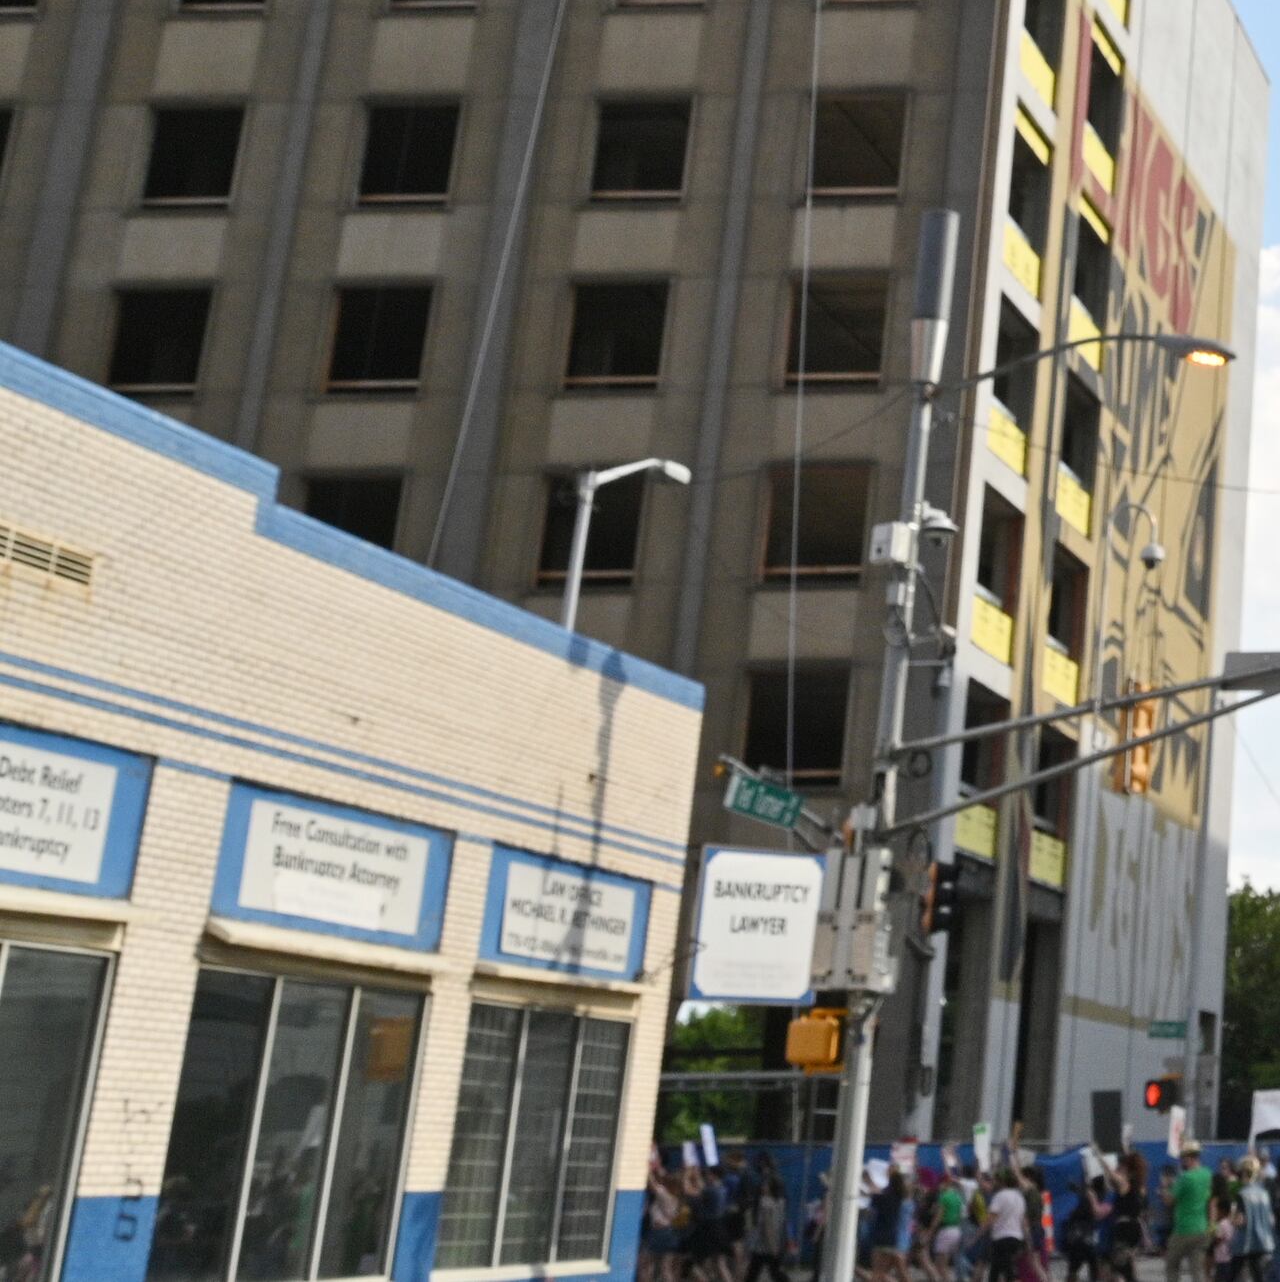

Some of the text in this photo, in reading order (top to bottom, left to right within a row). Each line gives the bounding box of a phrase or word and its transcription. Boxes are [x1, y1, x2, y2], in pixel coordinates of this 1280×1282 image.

[41, 764, 84, 794] Relief
[271, 811, 301, 838] Free
[305, 819, 380, 856] Consultation
[273, 846, 400, 893] Bankruptcy Attorney
[714, 879, 811, 904] BANKRUPTCY
[729, 914, 788, 937] LAWYER
